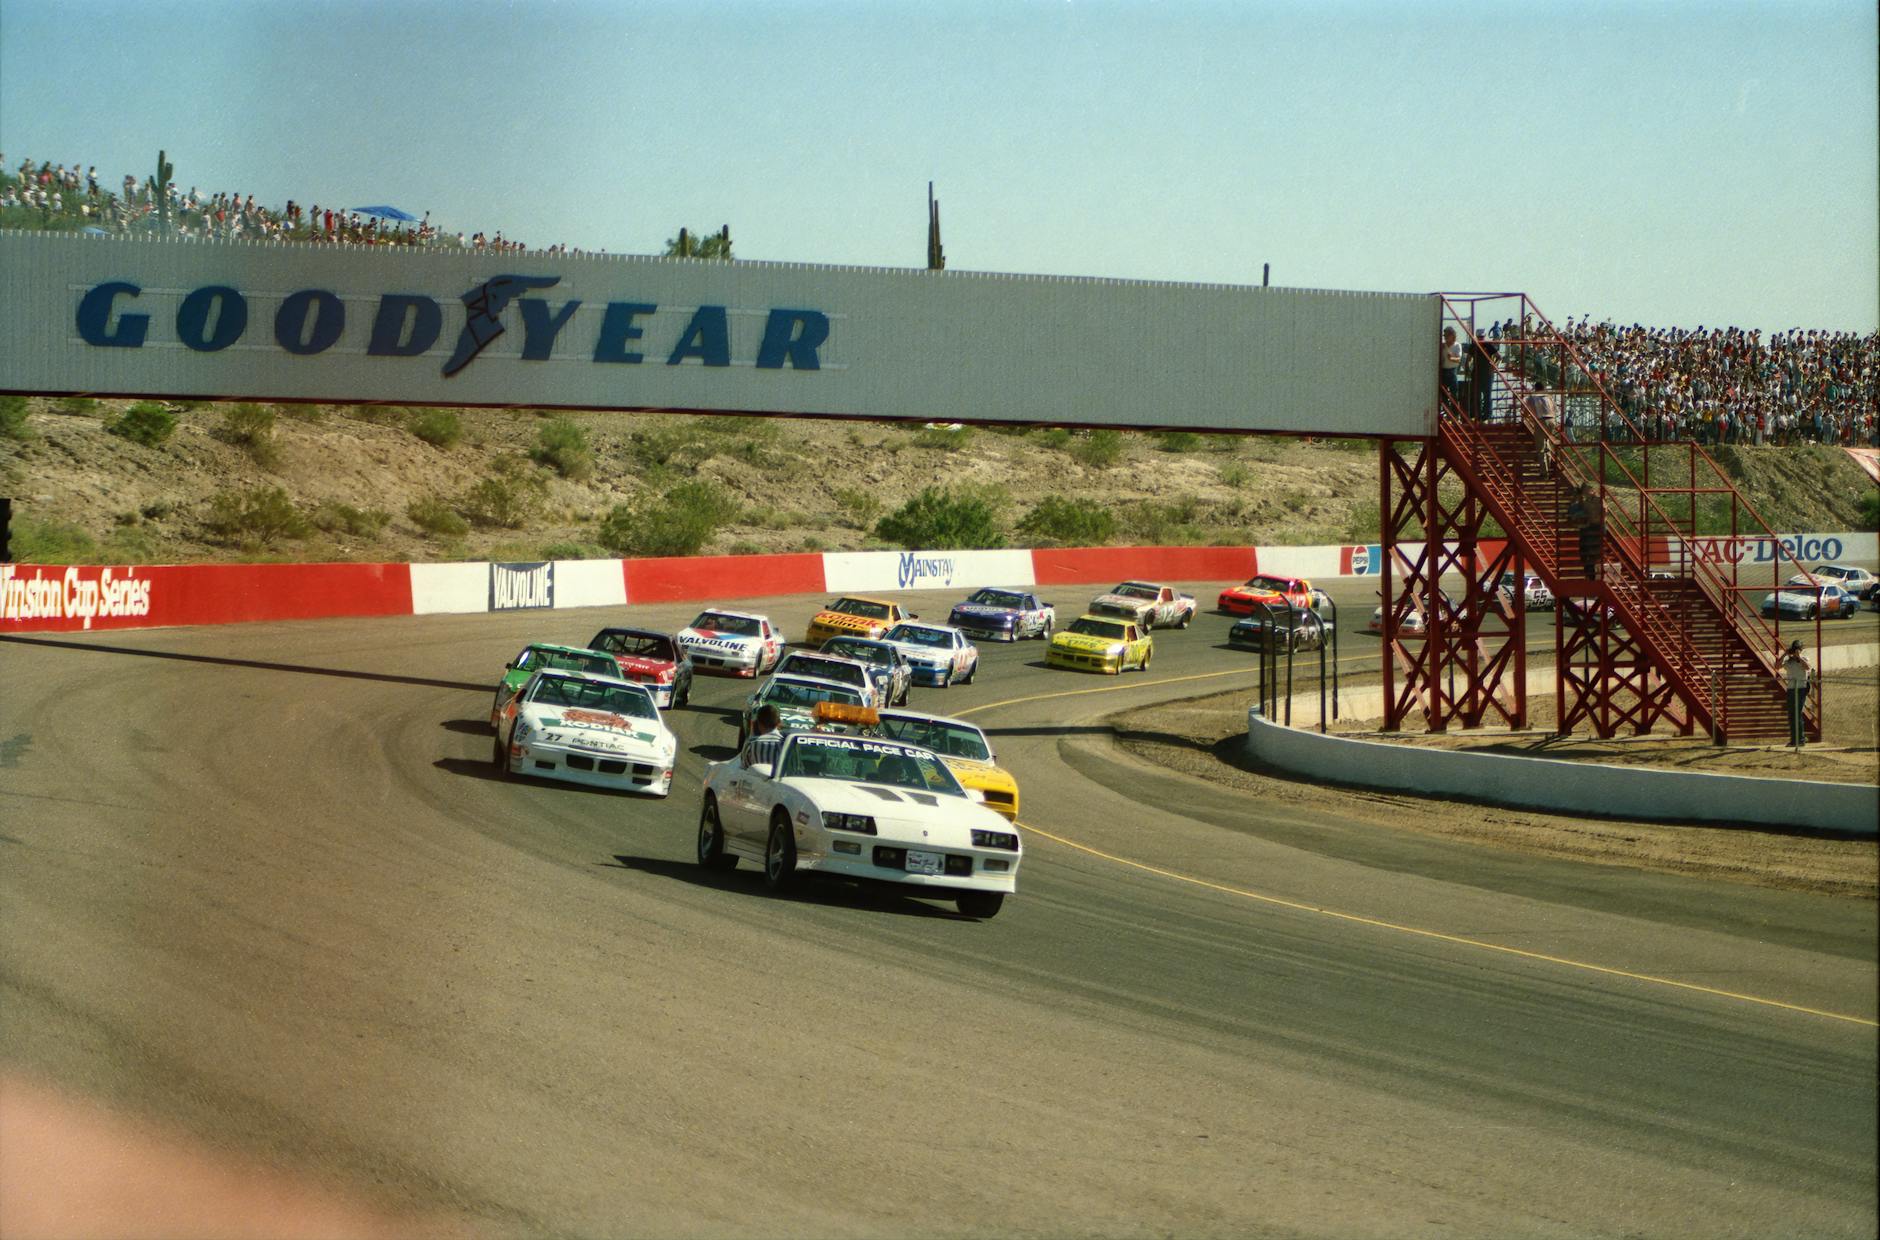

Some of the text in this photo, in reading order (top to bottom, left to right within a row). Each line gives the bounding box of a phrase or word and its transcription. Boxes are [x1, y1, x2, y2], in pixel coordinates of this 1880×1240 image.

[76, 276, 830, 374] GOODYEAR
[1353, 556, 1369, 565] PEPSI
[494, 562, 552, 609] VALVOLINE
[64, 566, 98, 630] Cup
[98, 566, 151, 617] Series
[679, 635, 749, 652] VALVOLINE
[546, 733, 563, 742] 27
[560, 719, 640, 739] KODIAK
[572, 738, 625, 751] PONTIAC
[797, 737, 935, 761] OFFICIAL PACE CAR
